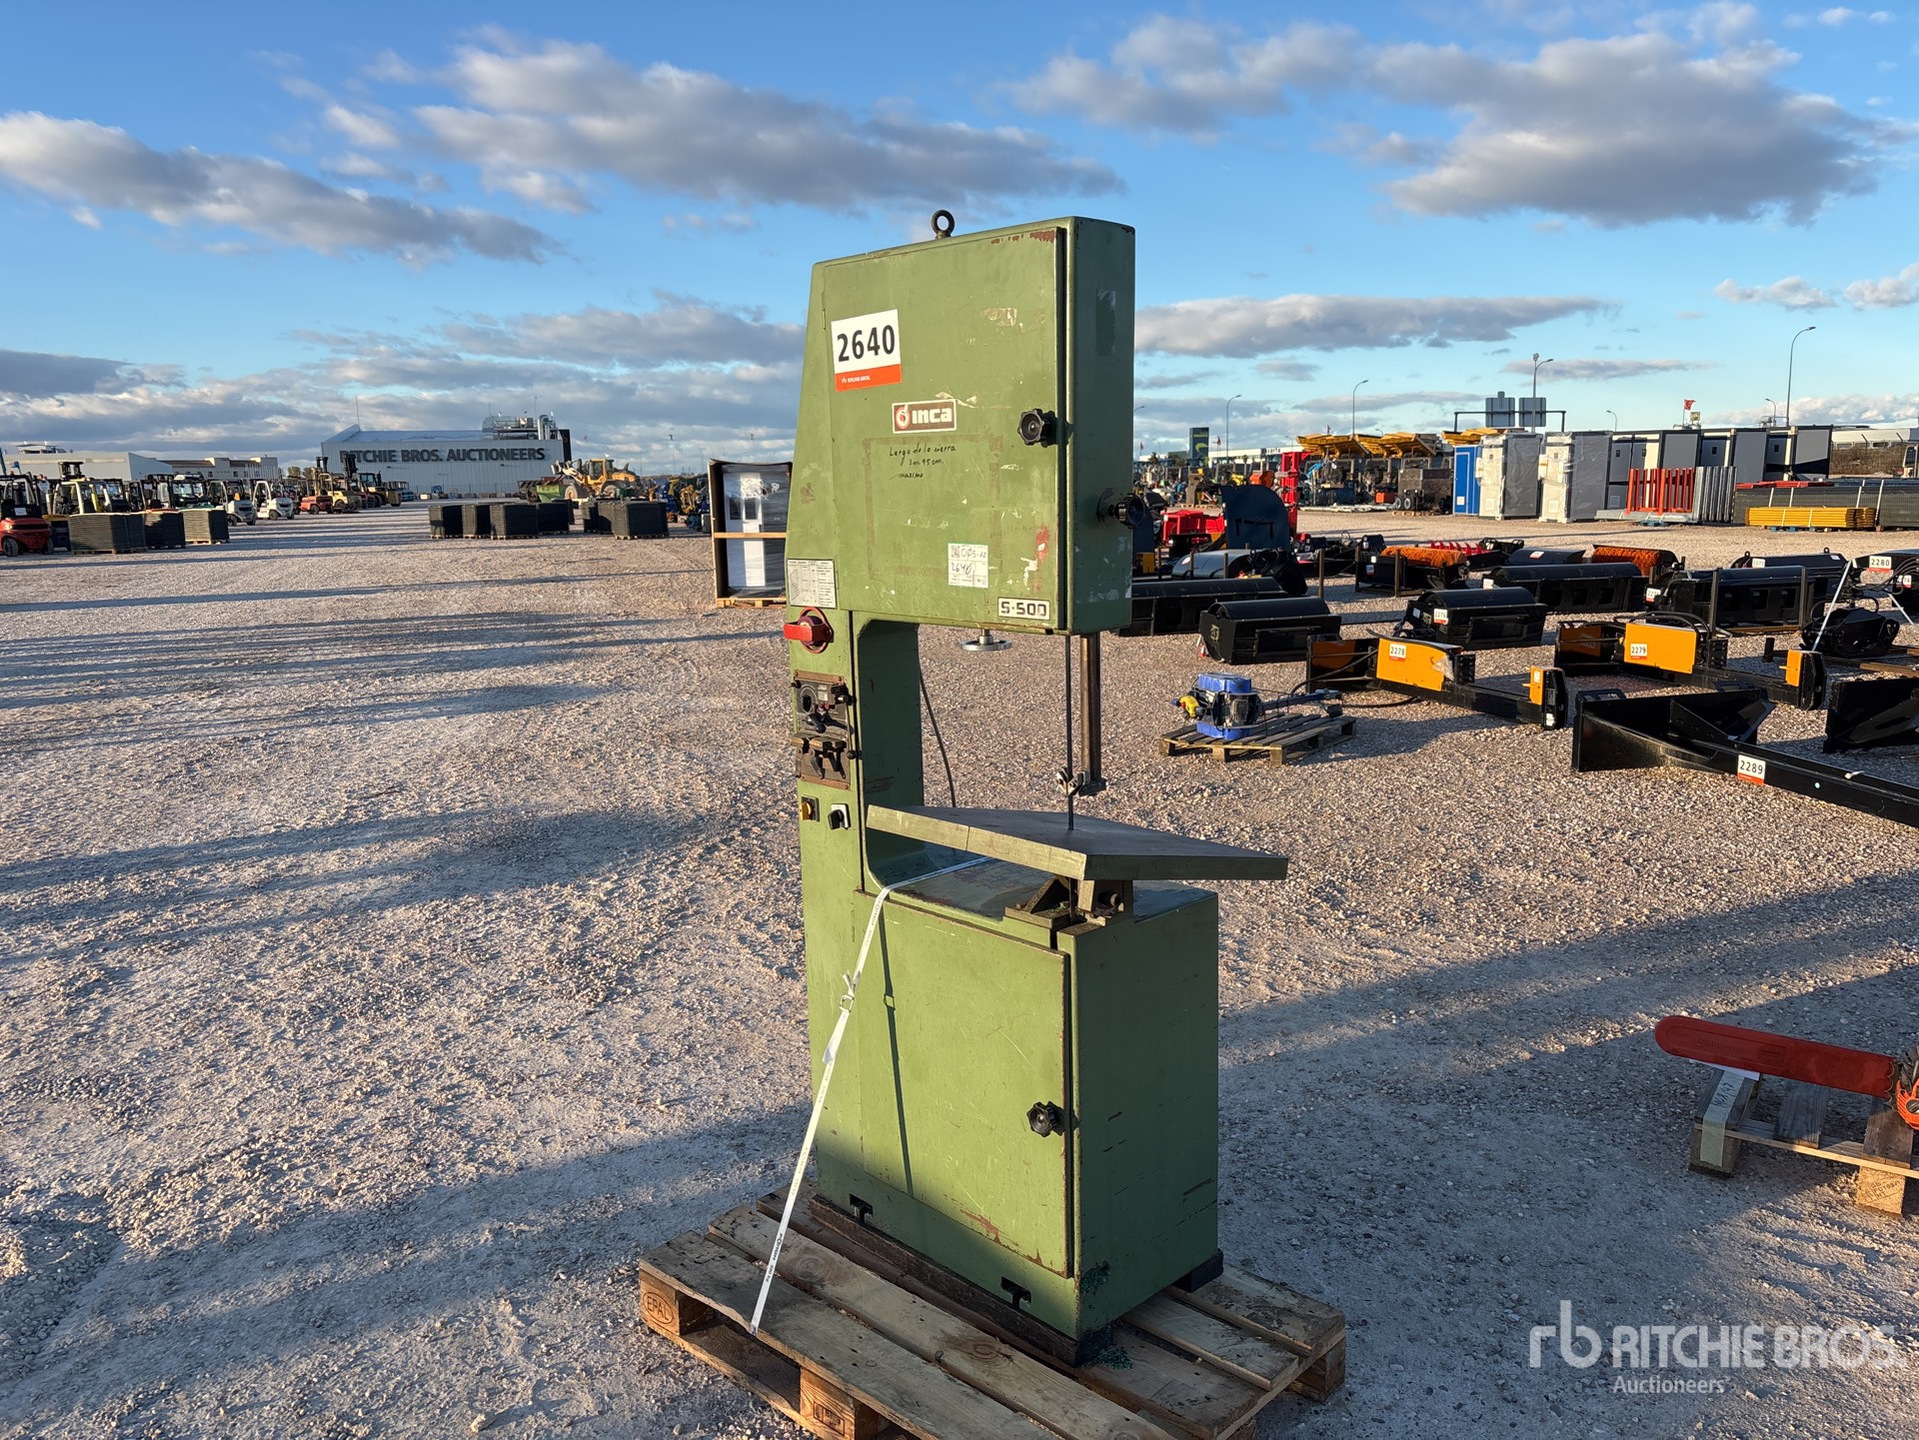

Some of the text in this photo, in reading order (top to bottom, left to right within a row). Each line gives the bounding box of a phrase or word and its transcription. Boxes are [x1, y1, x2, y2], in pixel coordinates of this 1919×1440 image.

[836, 325, 895, 362] 2640
[911, 407, 952, 425] inca
[401, 449, 443, 463] BROS.
[446, 447, 546, 462] AUCTIONEERS
[1871, 558, 1890, 567] 2280
[1631, 646, 1646, 655] 2279
[1740, 760, 1763, 774] 2289
[647, 1295, 670, 1321] EPAL
